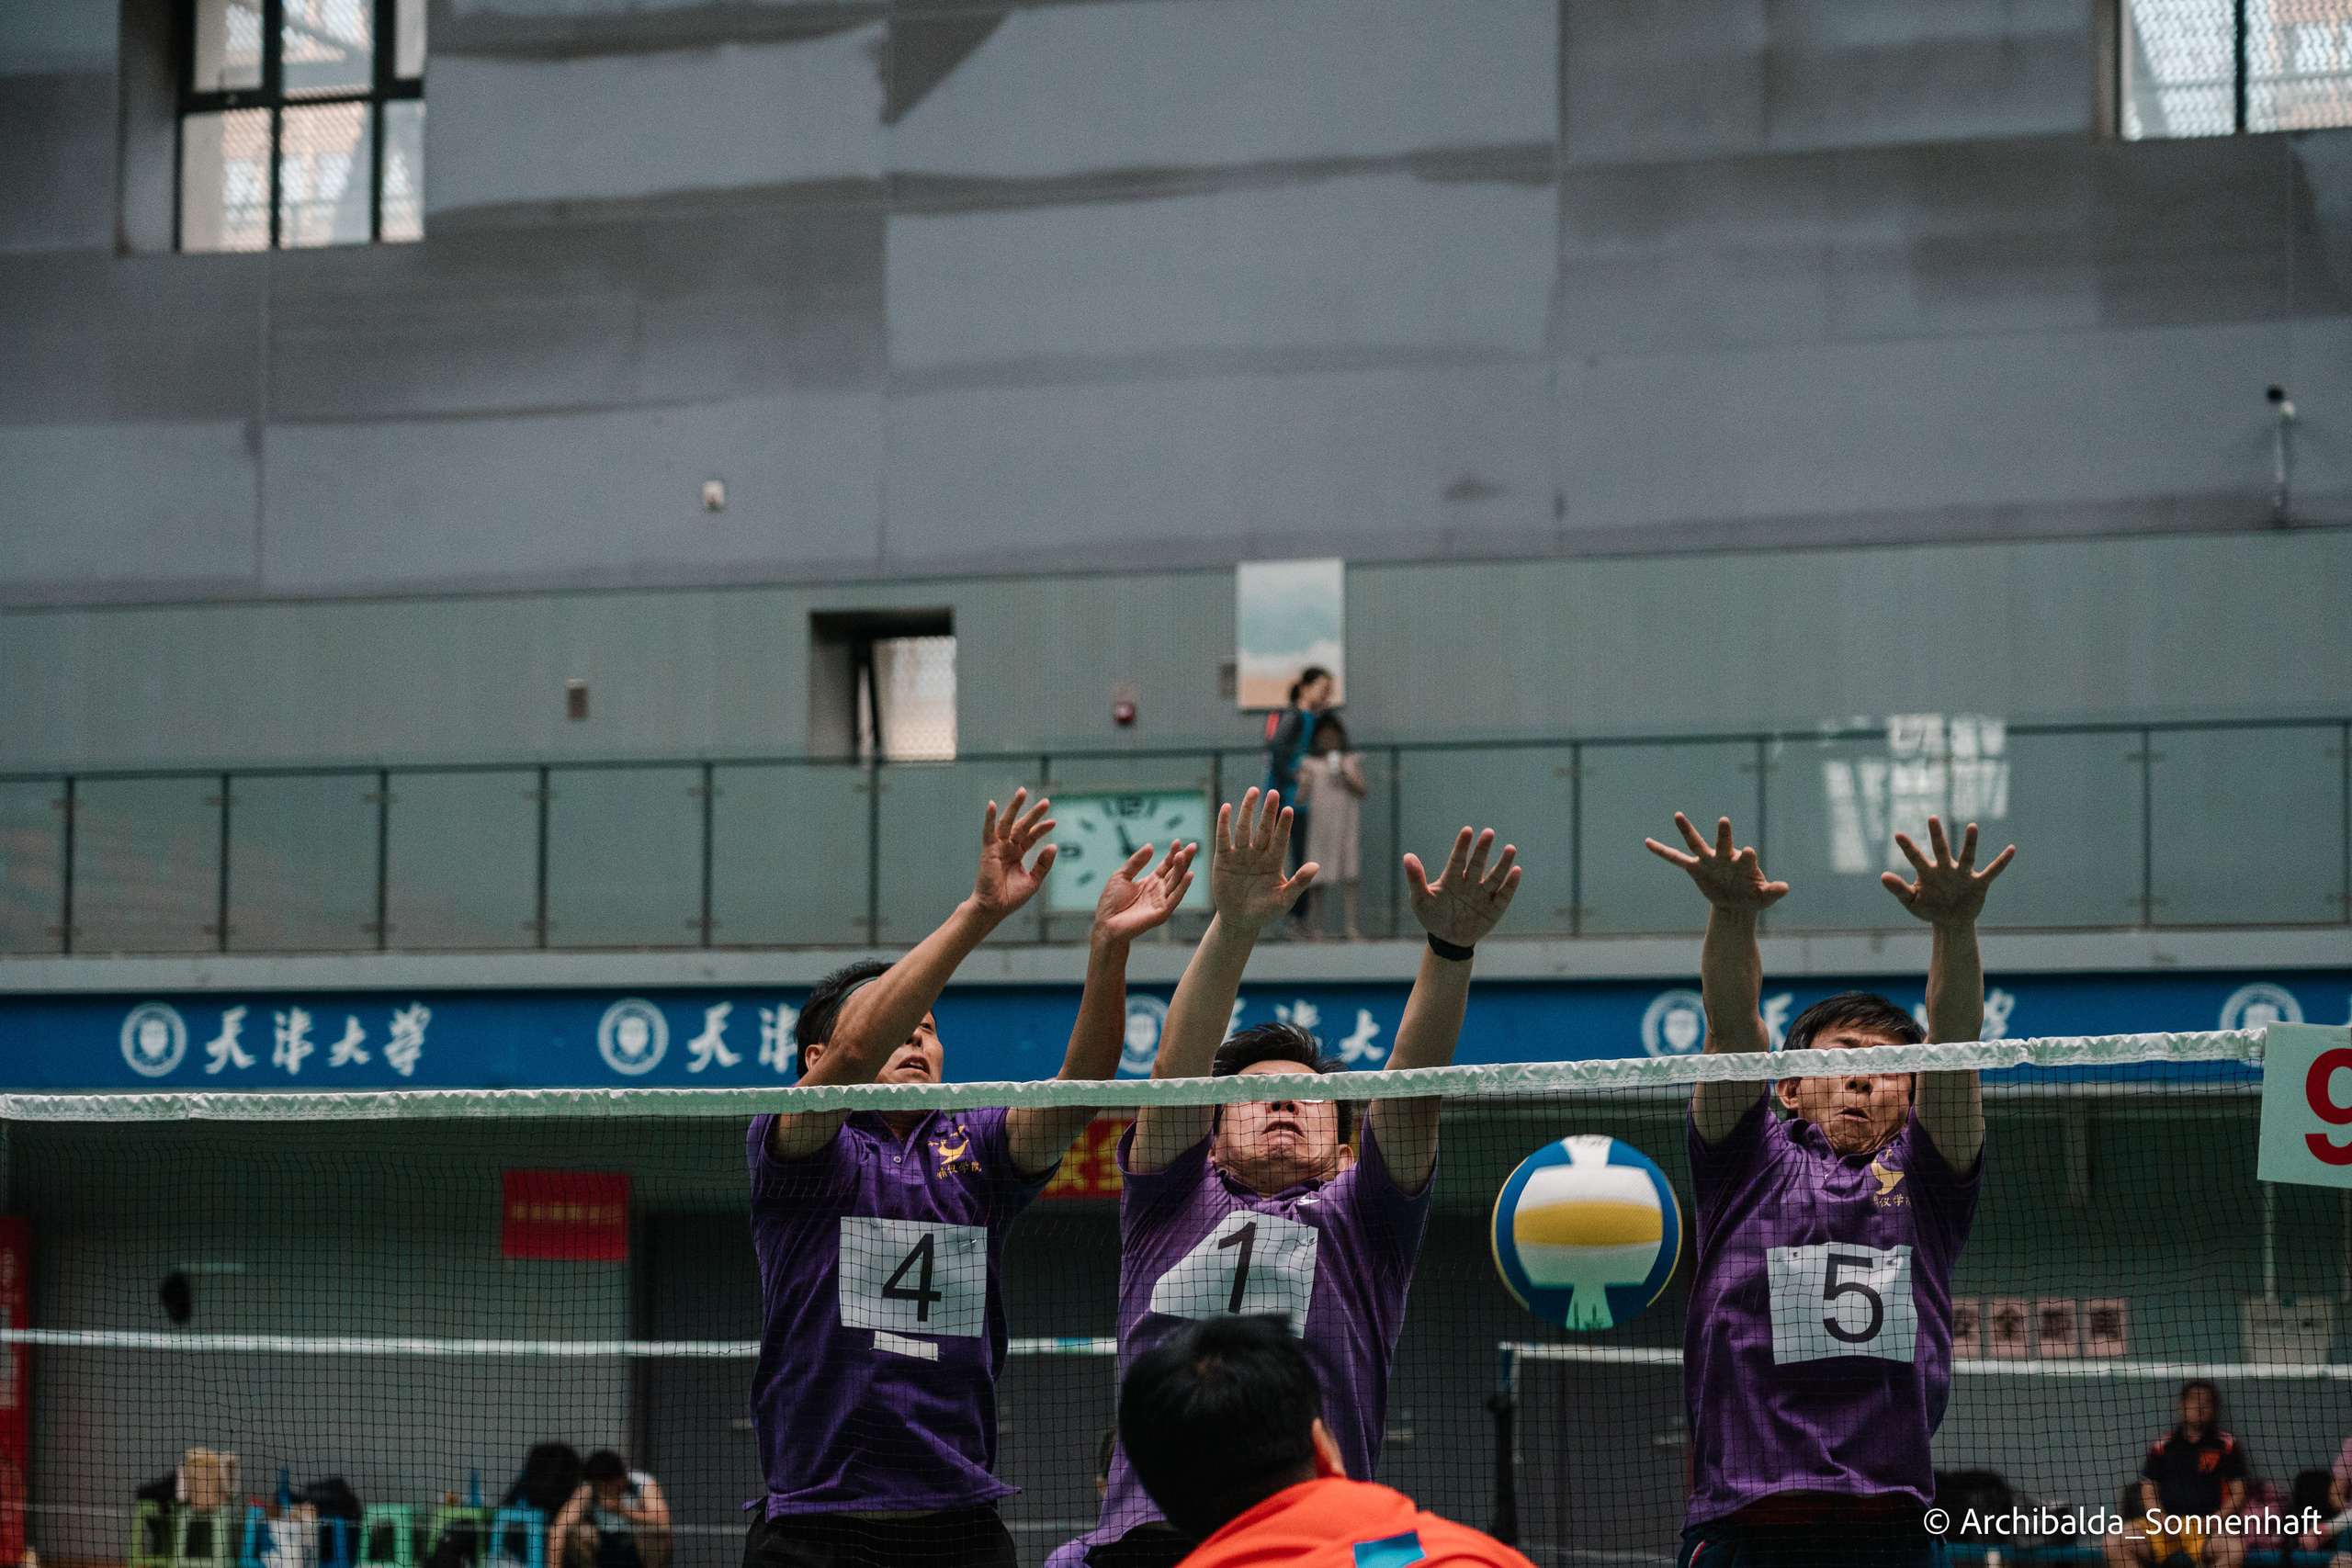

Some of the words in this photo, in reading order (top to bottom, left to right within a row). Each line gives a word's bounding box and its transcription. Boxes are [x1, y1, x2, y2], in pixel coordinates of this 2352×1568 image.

[204, 1001, 433, 1077] 天津大学
[882, 1233, 943, 1323] 4
[1217, 1221, 1257, 1315] 1
[1823, 1253, 1883, 1344] 5
